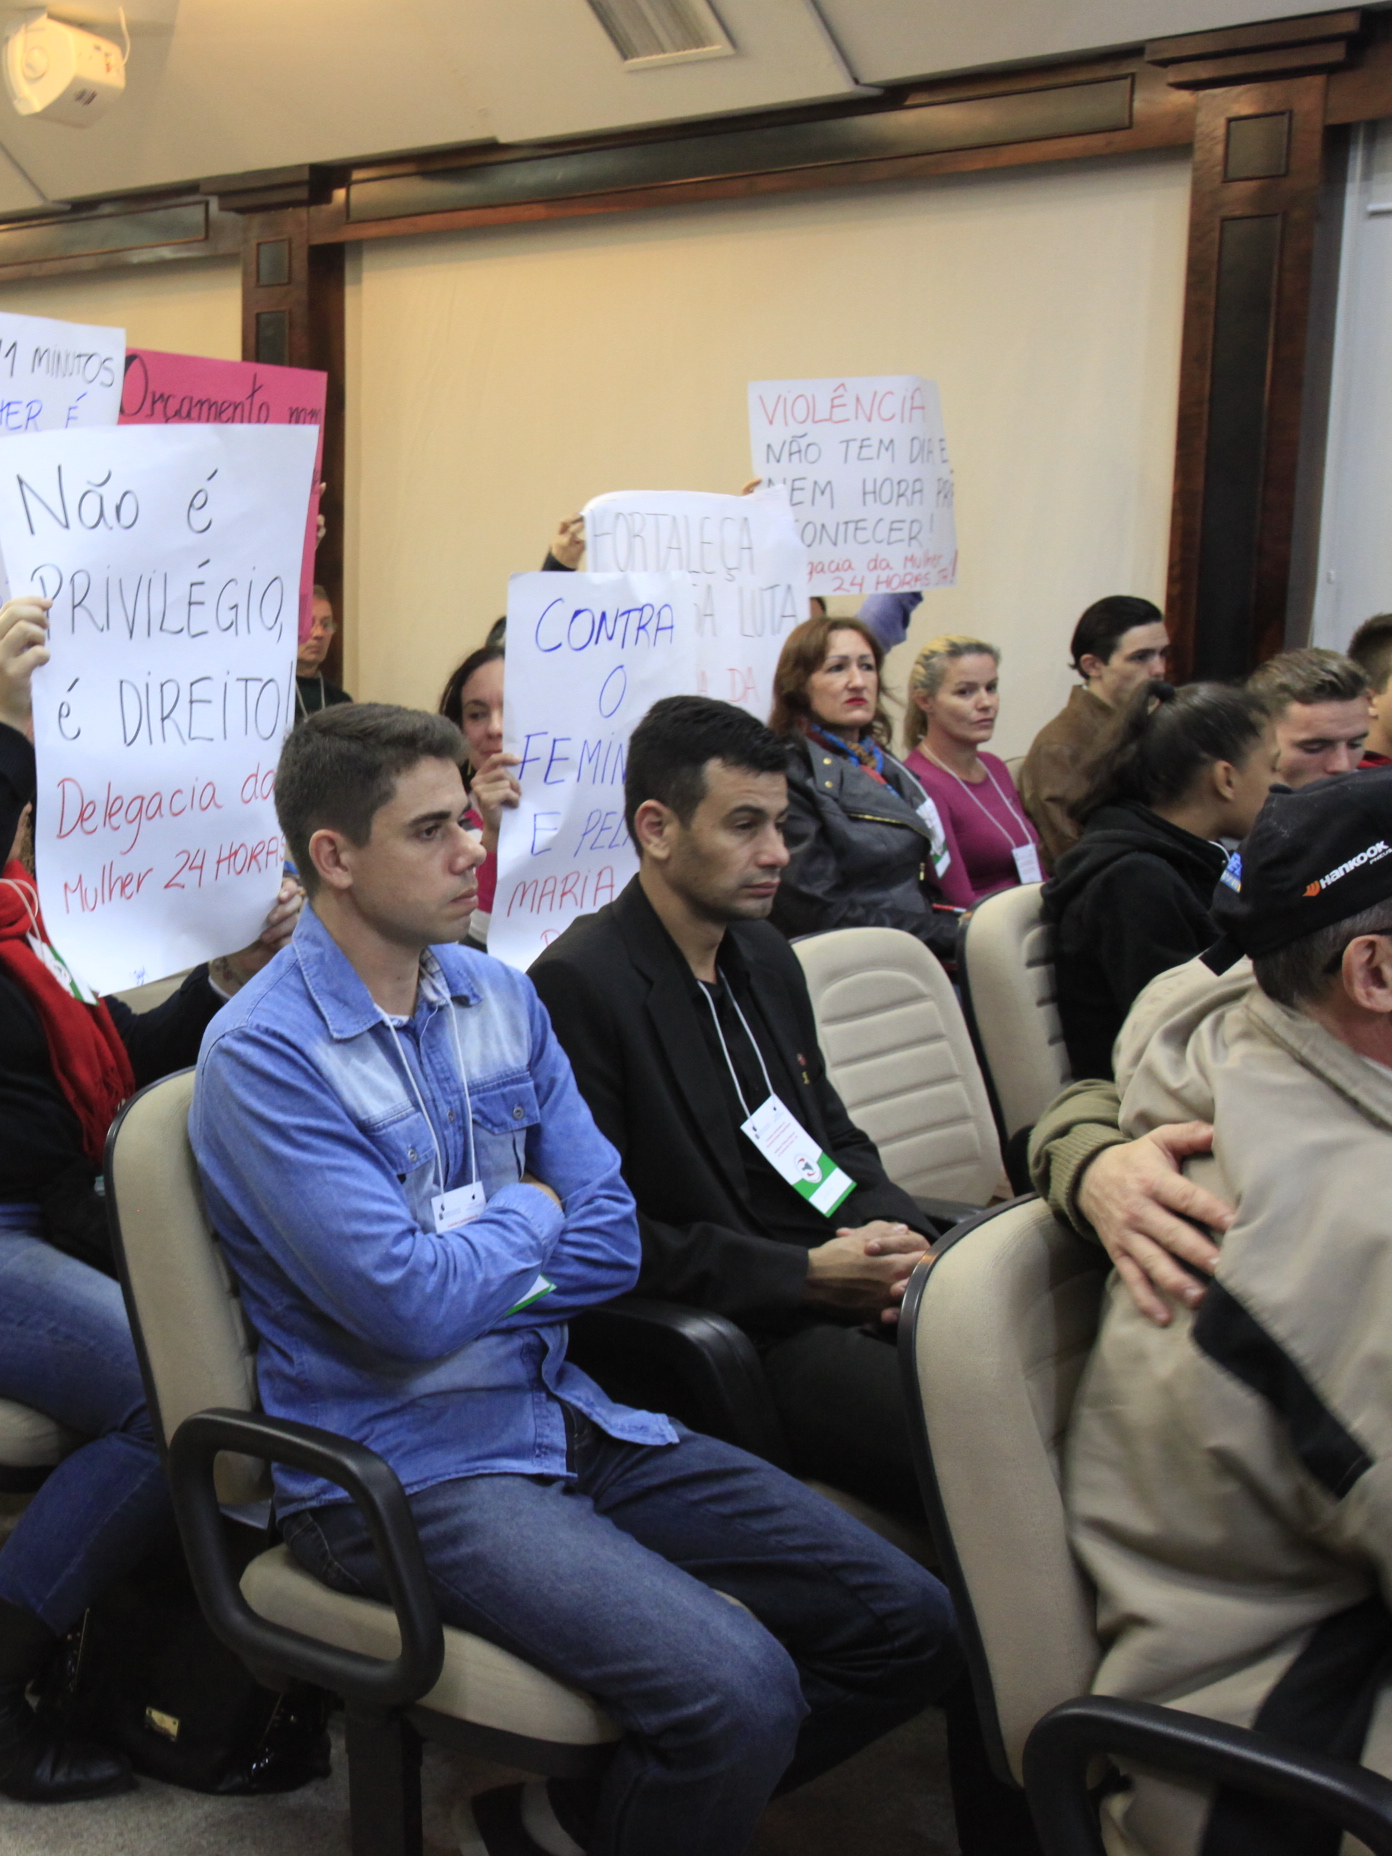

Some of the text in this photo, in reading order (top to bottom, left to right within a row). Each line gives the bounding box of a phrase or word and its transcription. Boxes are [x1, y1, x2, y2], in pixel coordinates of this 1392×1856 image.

[31, 347, 115, 388] MINUTOS
[119, 353, 271, 424] Orçamento
[759, 383, 926, 427] VIOLÊNCIA
[766, 432, 822, 465] NÃO
[839, 437, 895, 464] TEM
[15, 464, 219, 536] Não é
[862, 476, 923, 507] HORA
[832, 575, 865, 593] 24
[867, 553, 893, 573] da
[535, 597, 675, 653] CONTRA
[56, 677, 82, 742] é
[598, 665, 628, 718] O
[56, 777, 224, 856] Delegacia
[531, 809, 631, 858] E PEL
[63, 859, 154, 915] Mulher
[164, 848, 207, 890] 24
[507, 865, 615, 918] MARIA
